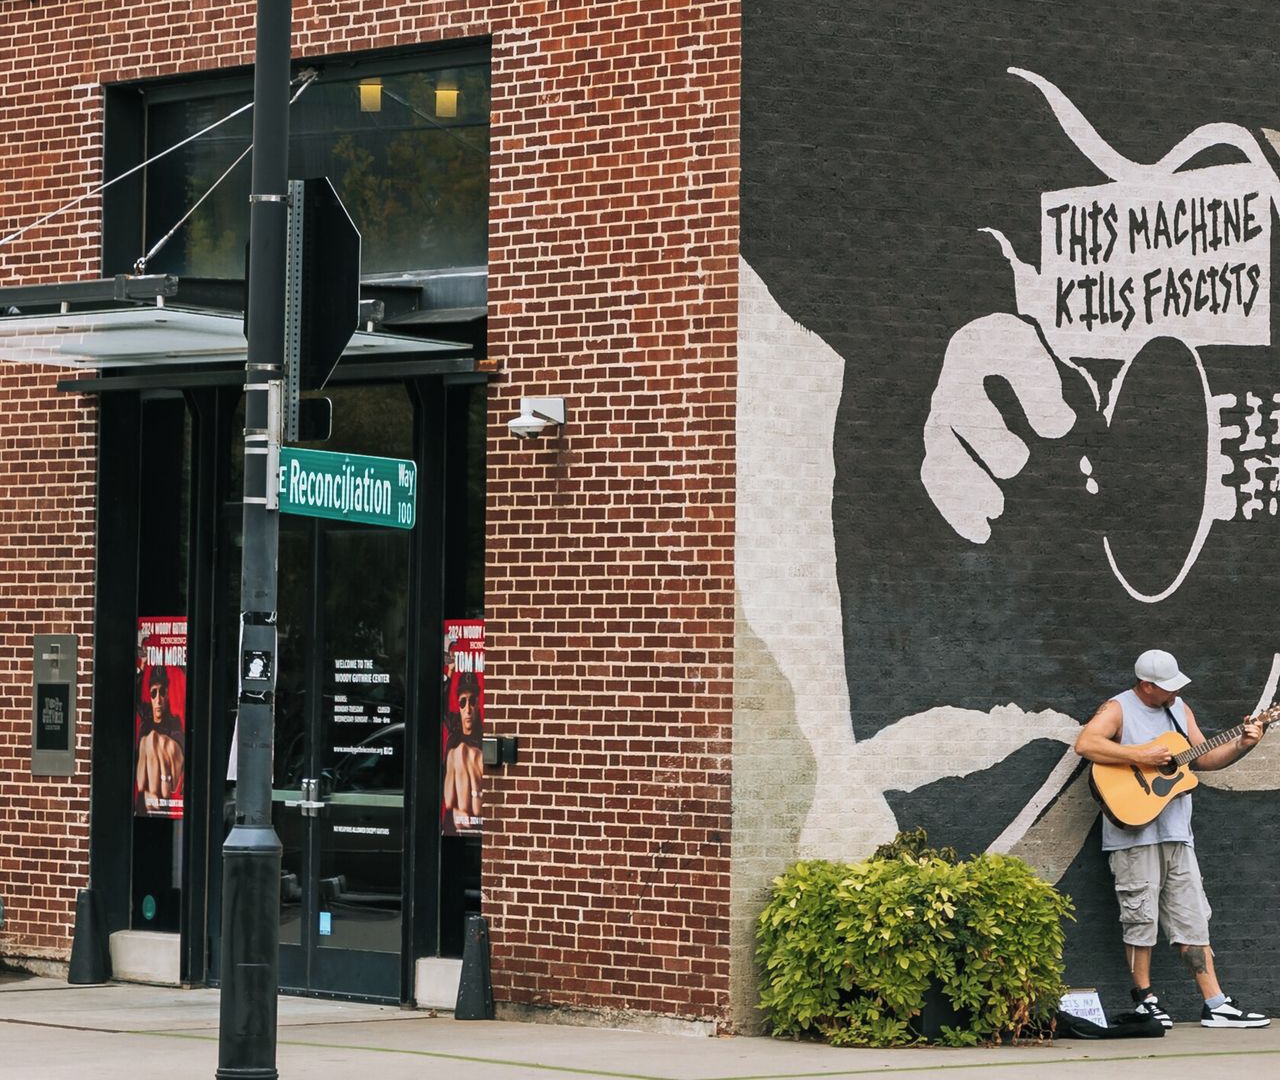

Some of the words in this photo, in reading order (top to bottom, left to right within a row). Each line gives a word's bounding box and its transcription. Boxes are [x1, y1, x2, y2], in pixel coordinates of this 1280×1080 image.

[1047, 201, 1117, 265] THIS
[1129, 192, 1263, 256] MACHINE
[1055, 271, 1136, 331] KILLS
[1144, 262, 1261, 325] FASCISTS
[279, 466, 287, 493] E
[289, 459, 392, 516] Reconciliation
[398, 463, 415, 495] Way
[398, 502, 412, 524] 100
[147, 646, 163, 666] TOM
[454, 651, 473, 672] TOM
